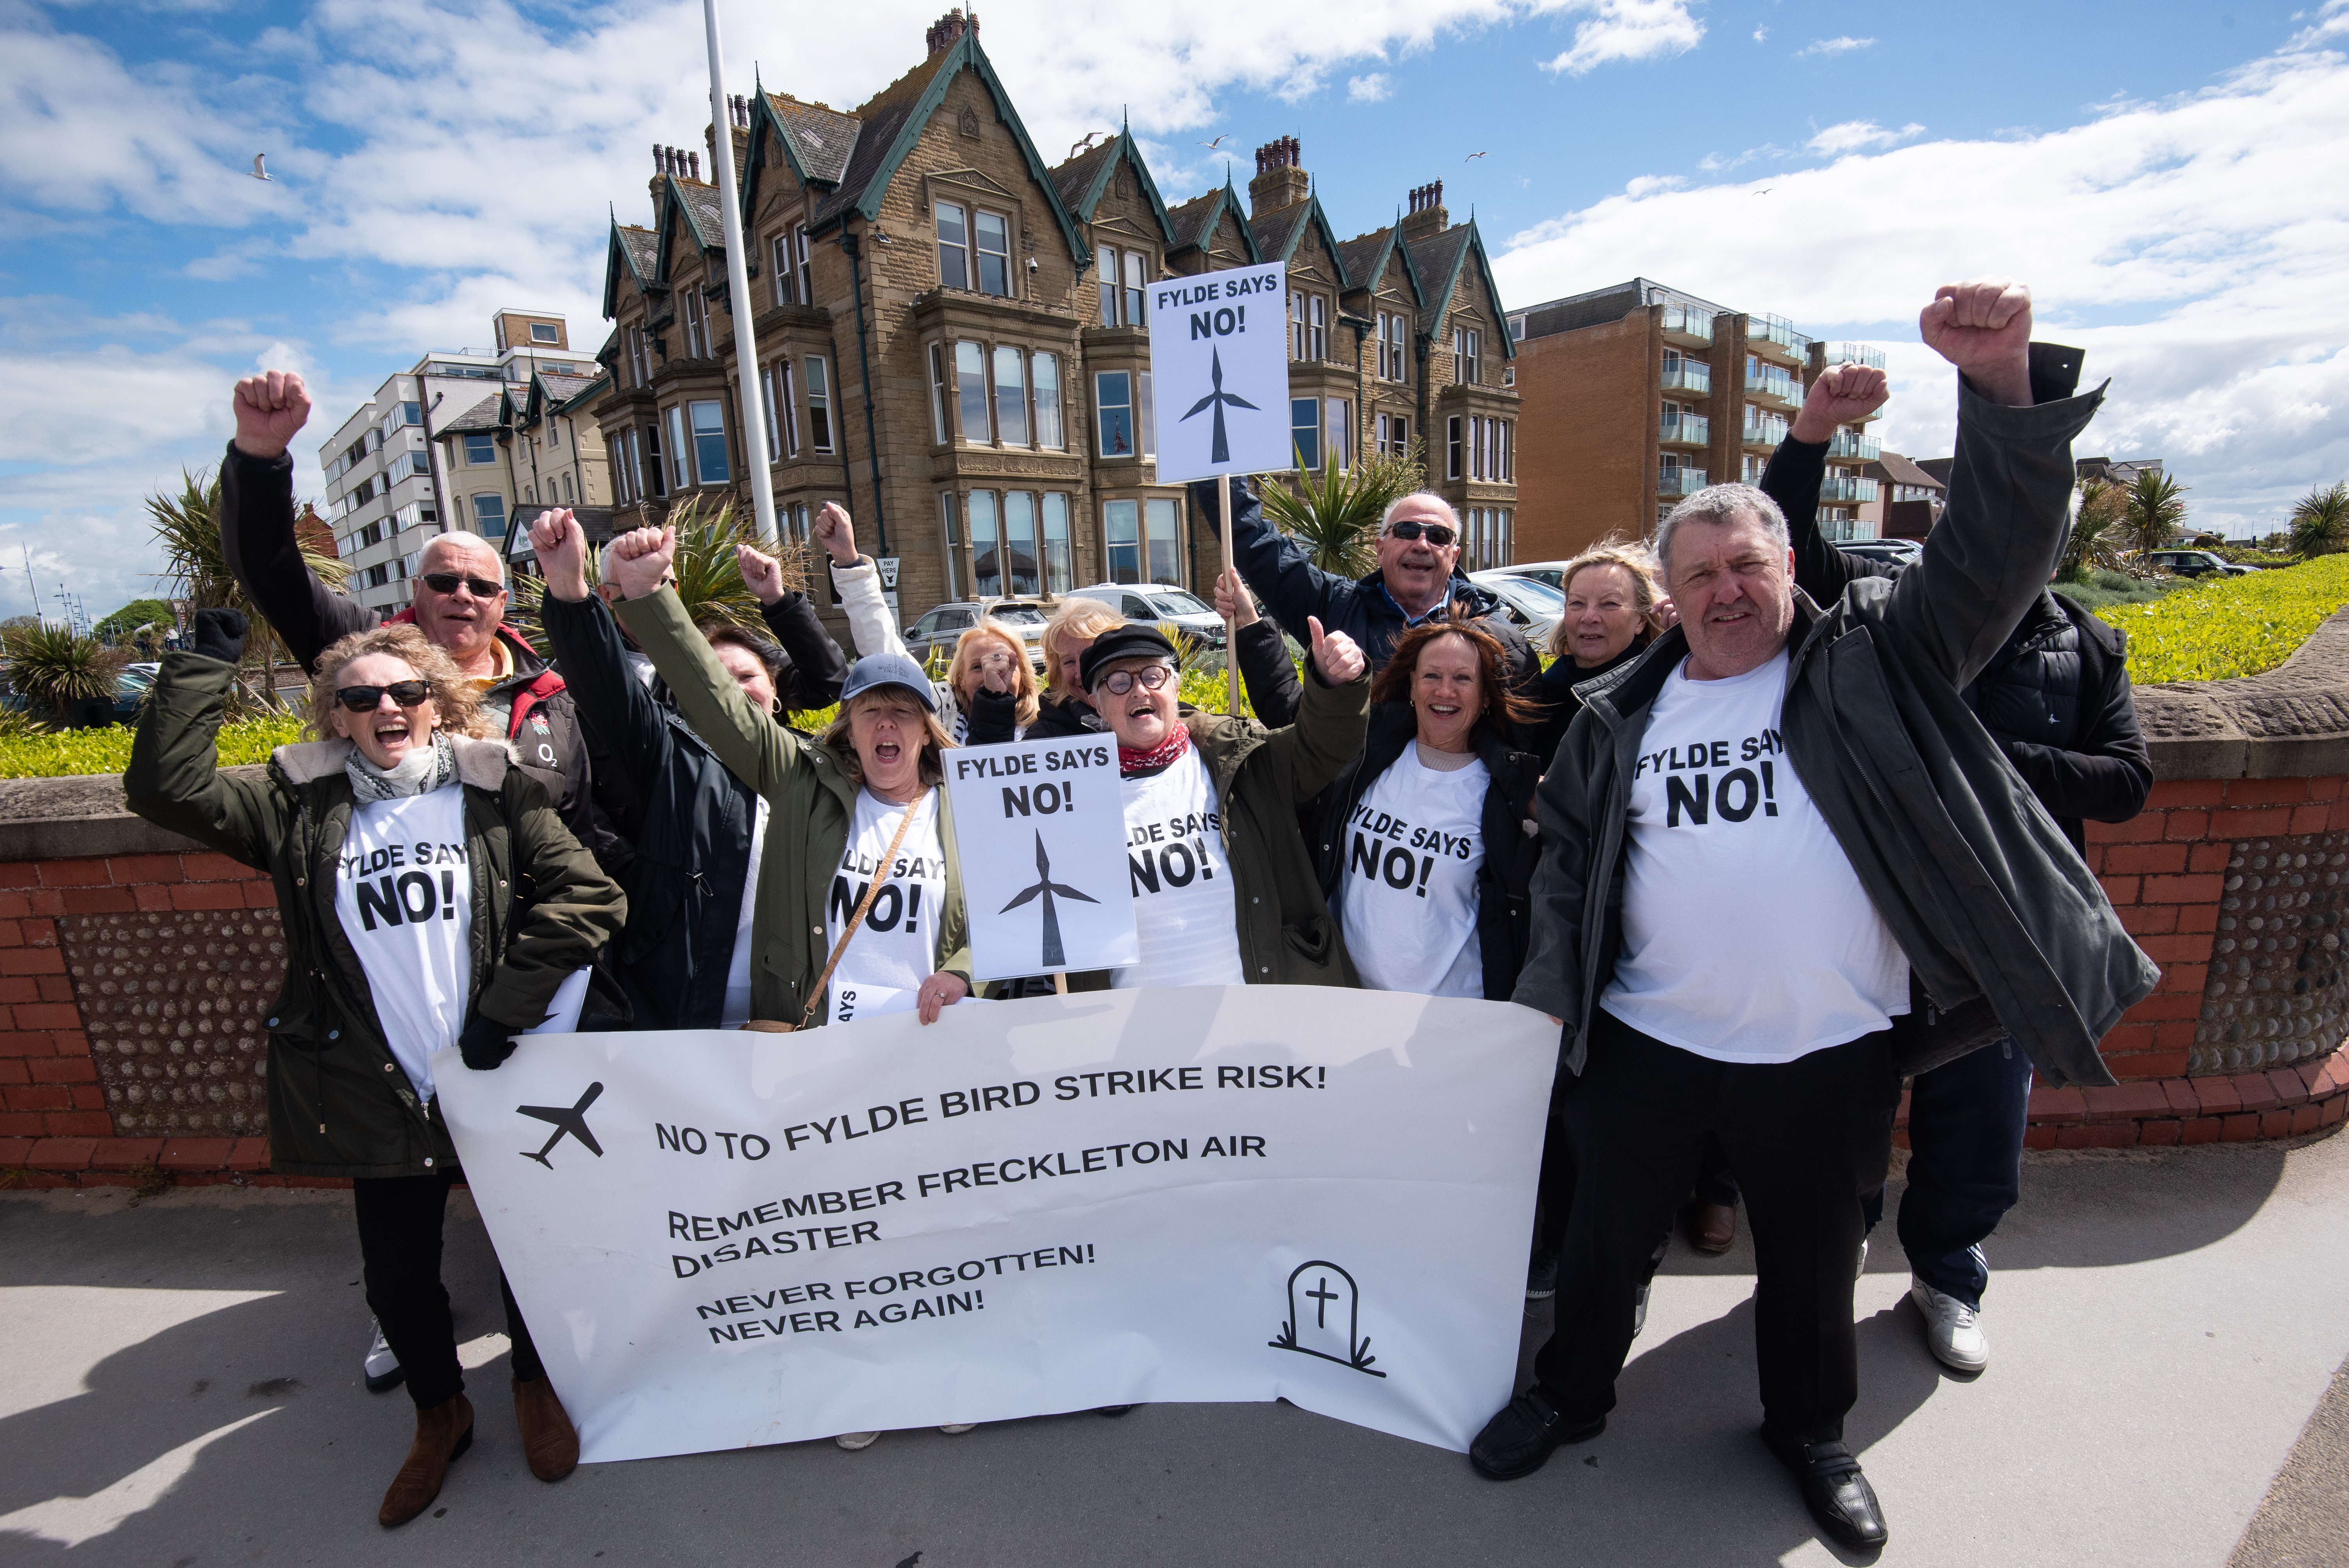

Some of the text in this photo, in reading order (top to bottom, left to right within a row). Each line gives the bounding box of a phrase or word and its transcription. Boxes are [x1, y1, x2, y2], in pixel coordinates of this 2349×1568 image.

[1158, 274, 1277, 309] FYLDE SAYS
[1191, 305, 1246, 340] NO!
[957, 747, 1109, 780] FYLDE SAYS
[1635, 729, 1783, 780] FYLDE SAY
[1002, 781, 1073, 818] NO!
[1666, 761, 1778, 828] NO!
[1170, 812, 1220, 838] SAYS
[1352, 804, 1471, 860] YLDE SAYS
[415, 842, 467, 865] SAY
[893, 857, 946, 880] SAY
[1128, 837, 1213, 898] NO!
[1351, 831, 1435, 898] NO!
[356, 870, 454, 931] NO!
[831, 875, 921, 933] NO!
[838, 991, 856, 1022] AYS
[656, 1066, 1326, 1160] NO TO FYLDE BIRD STRIKE RISK!
[669, 1135, 1267, 1241] REMEMBER FRECKLETON AIR
[672, 1221, 882, 1279] DISASTER
[696, 1244, 1095, 1320] NEVER FORGOTTEN!
[709, 1290, 984, 1344] NEVER AGAIN!
